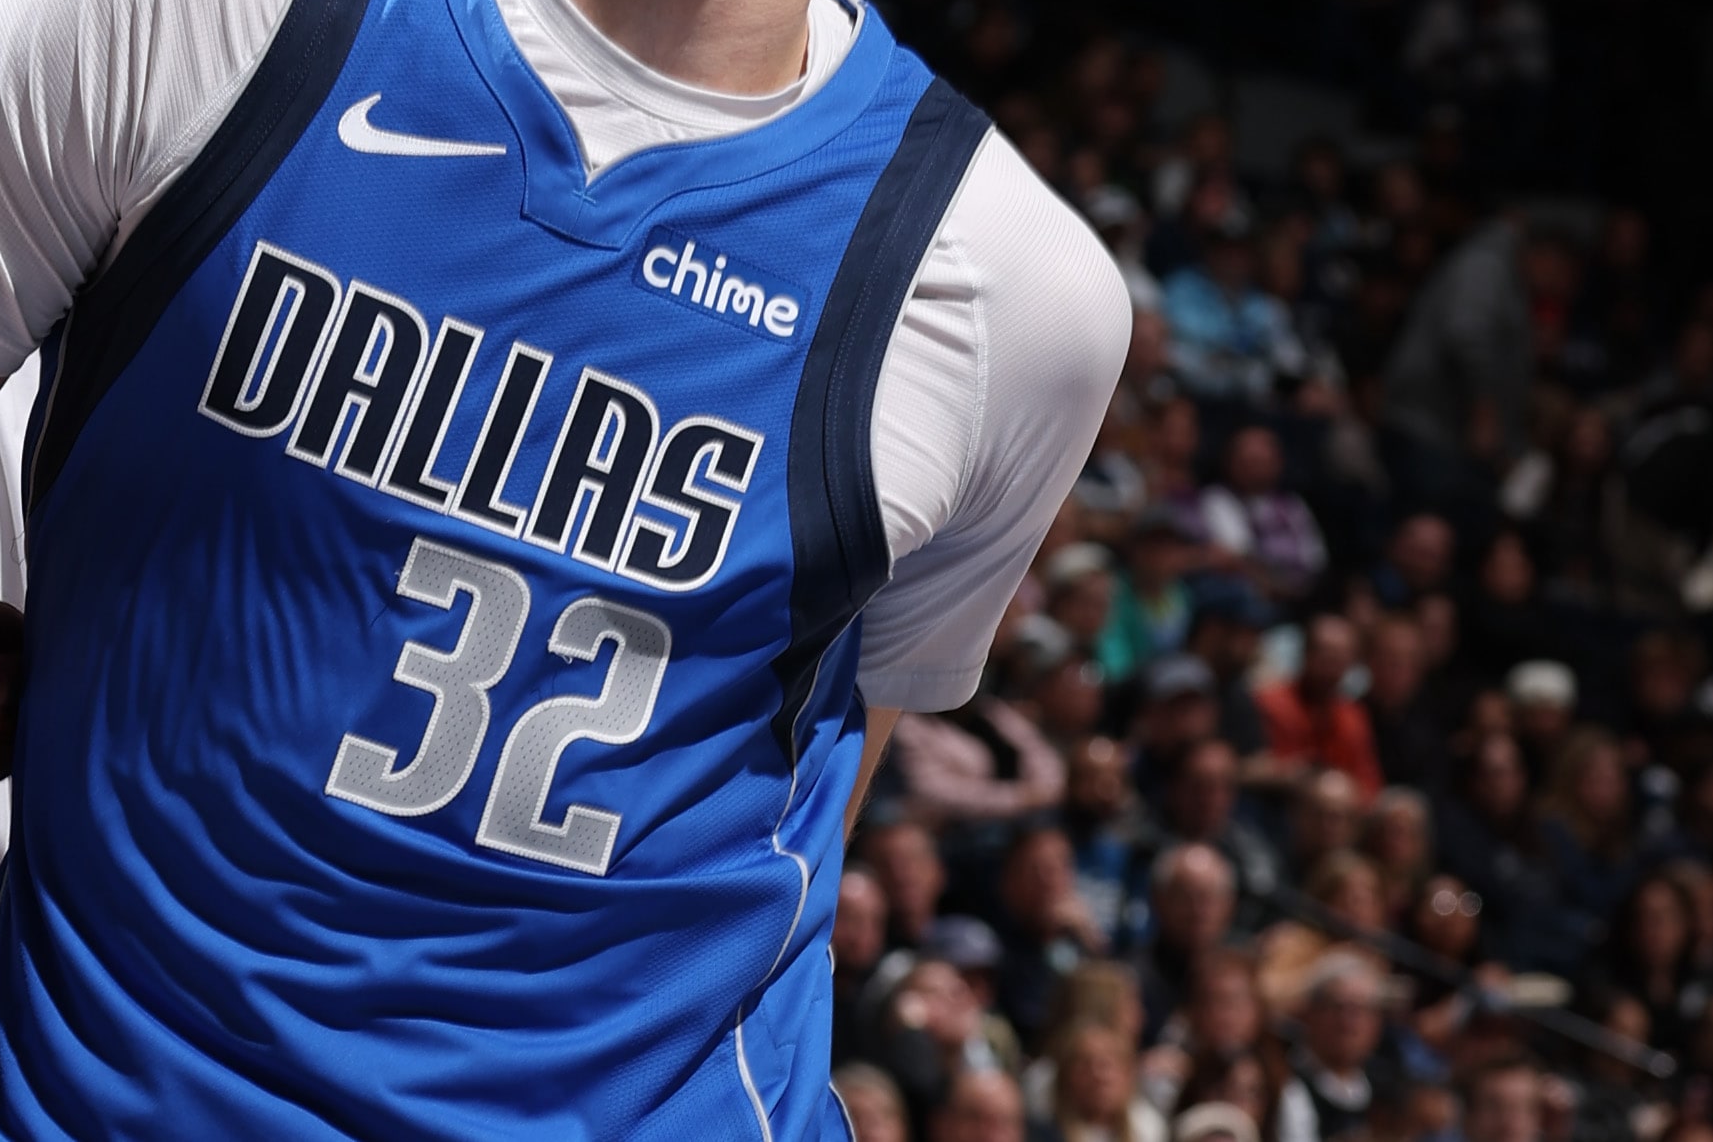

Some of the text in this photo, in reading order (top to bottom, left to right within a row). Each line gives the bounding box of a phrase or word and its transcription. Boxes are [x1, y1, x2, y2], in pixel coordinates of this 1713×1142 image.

[197, 240, 765, 592] DALLAS
[641, 240, 800, 339] chime
[325, 536, 672, 877] 32
